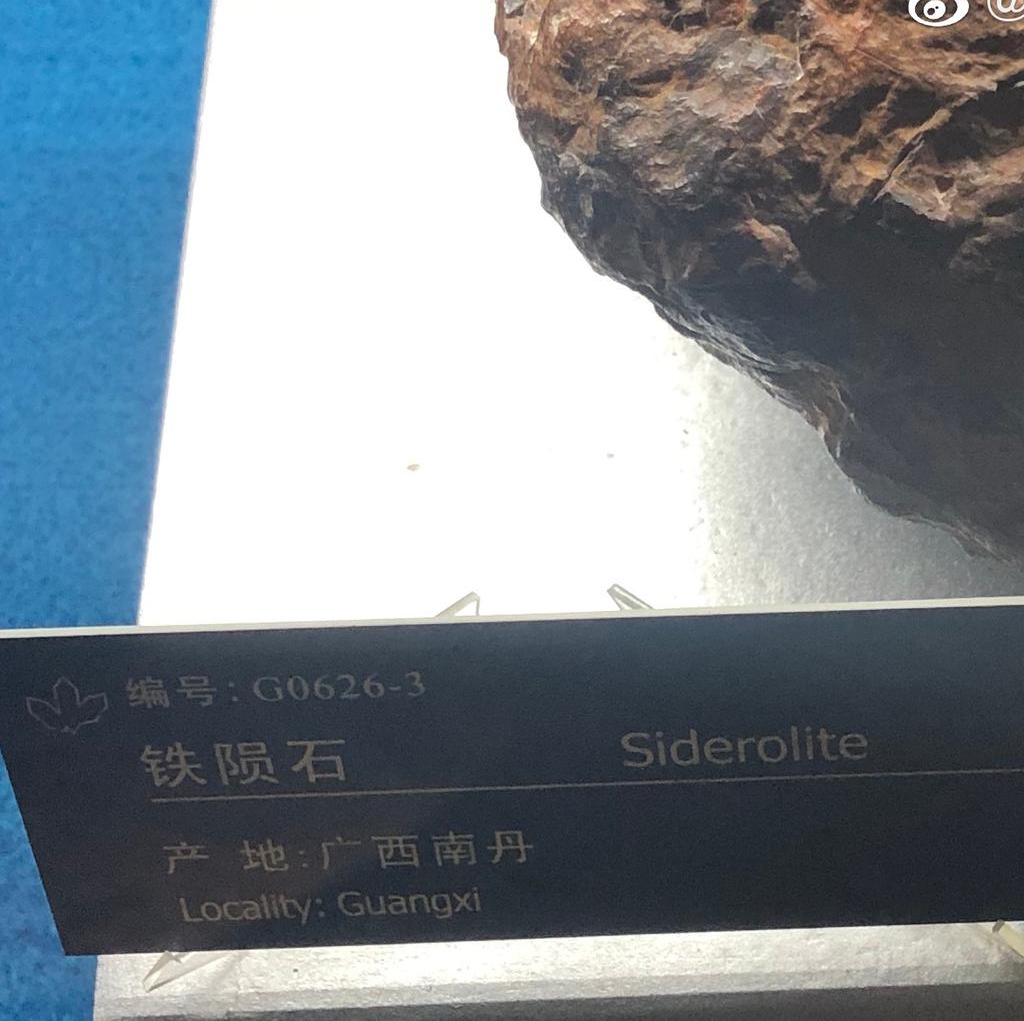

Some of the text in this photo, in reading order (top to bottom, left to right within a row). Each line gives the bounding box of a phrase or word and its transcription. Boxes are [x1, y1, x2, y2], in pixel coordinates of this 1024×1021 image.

[140, 738, 347, 788] 铁陨石
[620, 725, 869, 769] Siderolite
[180, 887, 482, 925] Locality: Guangxi
